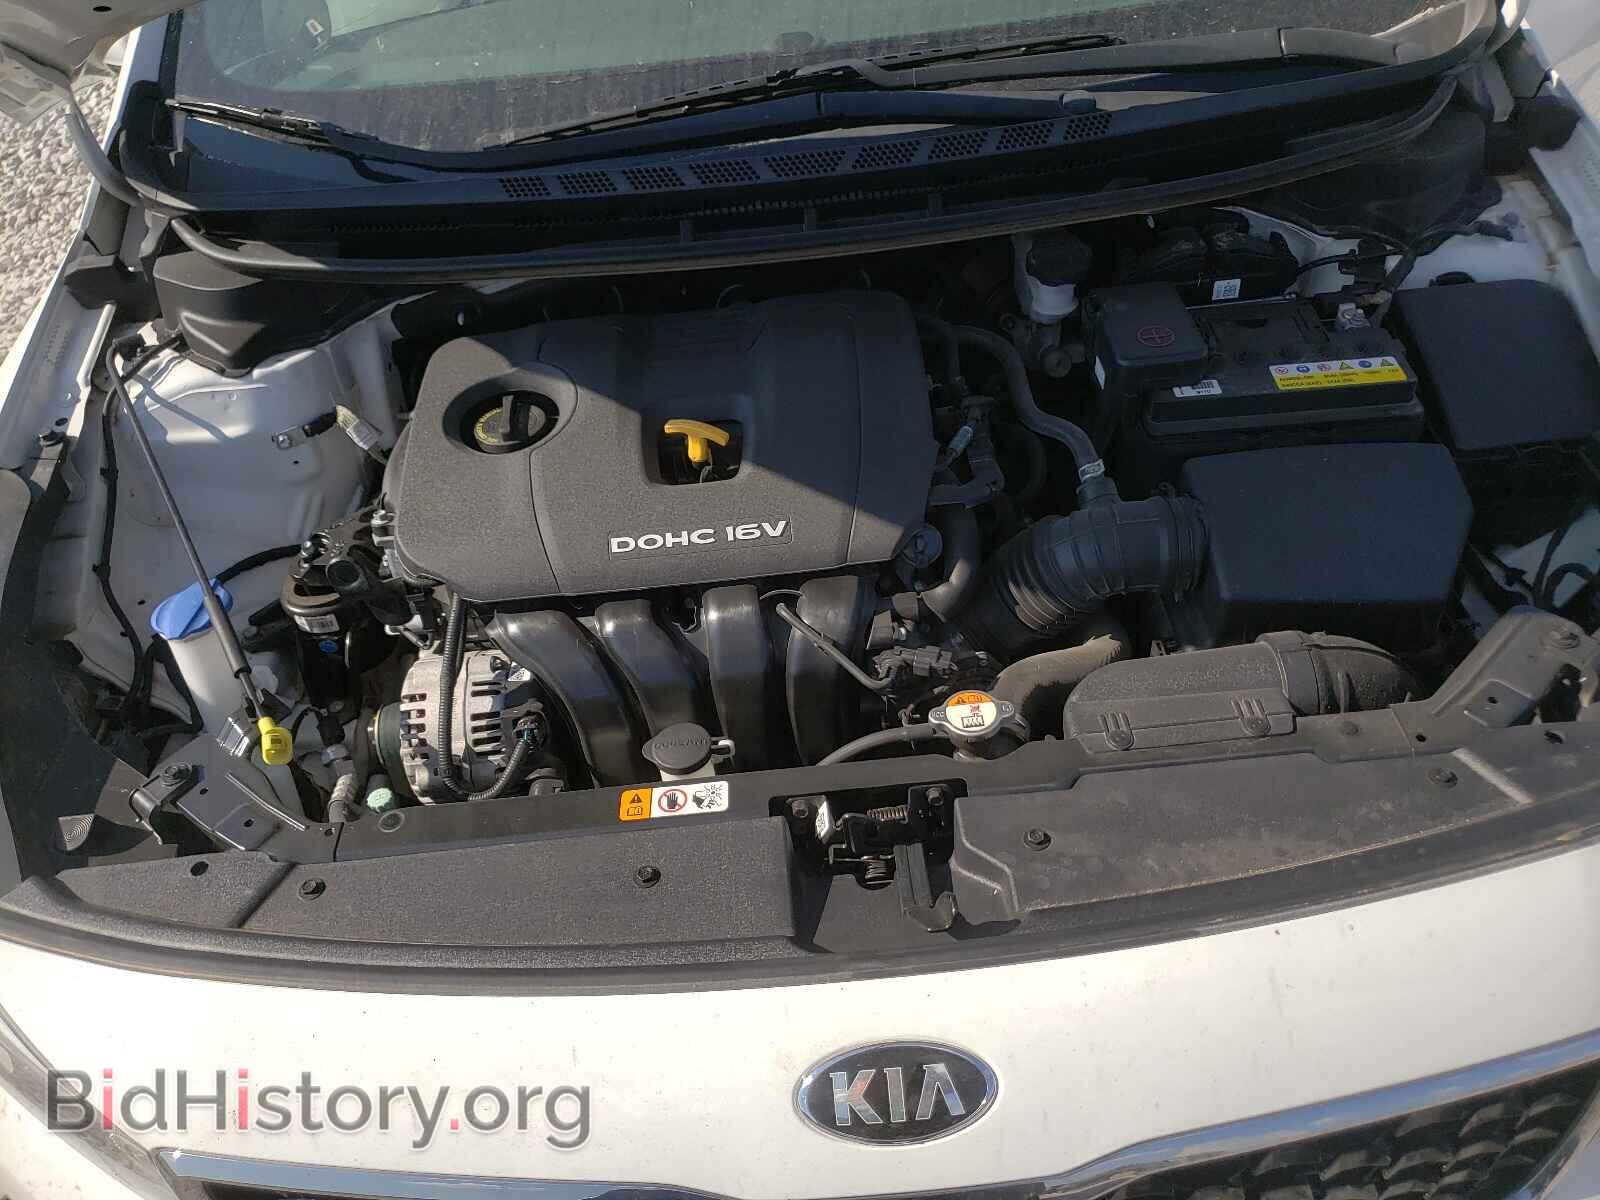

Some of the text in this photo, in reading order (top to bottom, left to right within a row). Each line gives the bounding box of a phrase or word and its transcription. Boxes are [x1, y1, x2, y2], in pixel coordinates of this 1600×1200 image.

[610, 520, 787, 553] DOHC 16V
[829, 1062, 966, 1126] KIA
